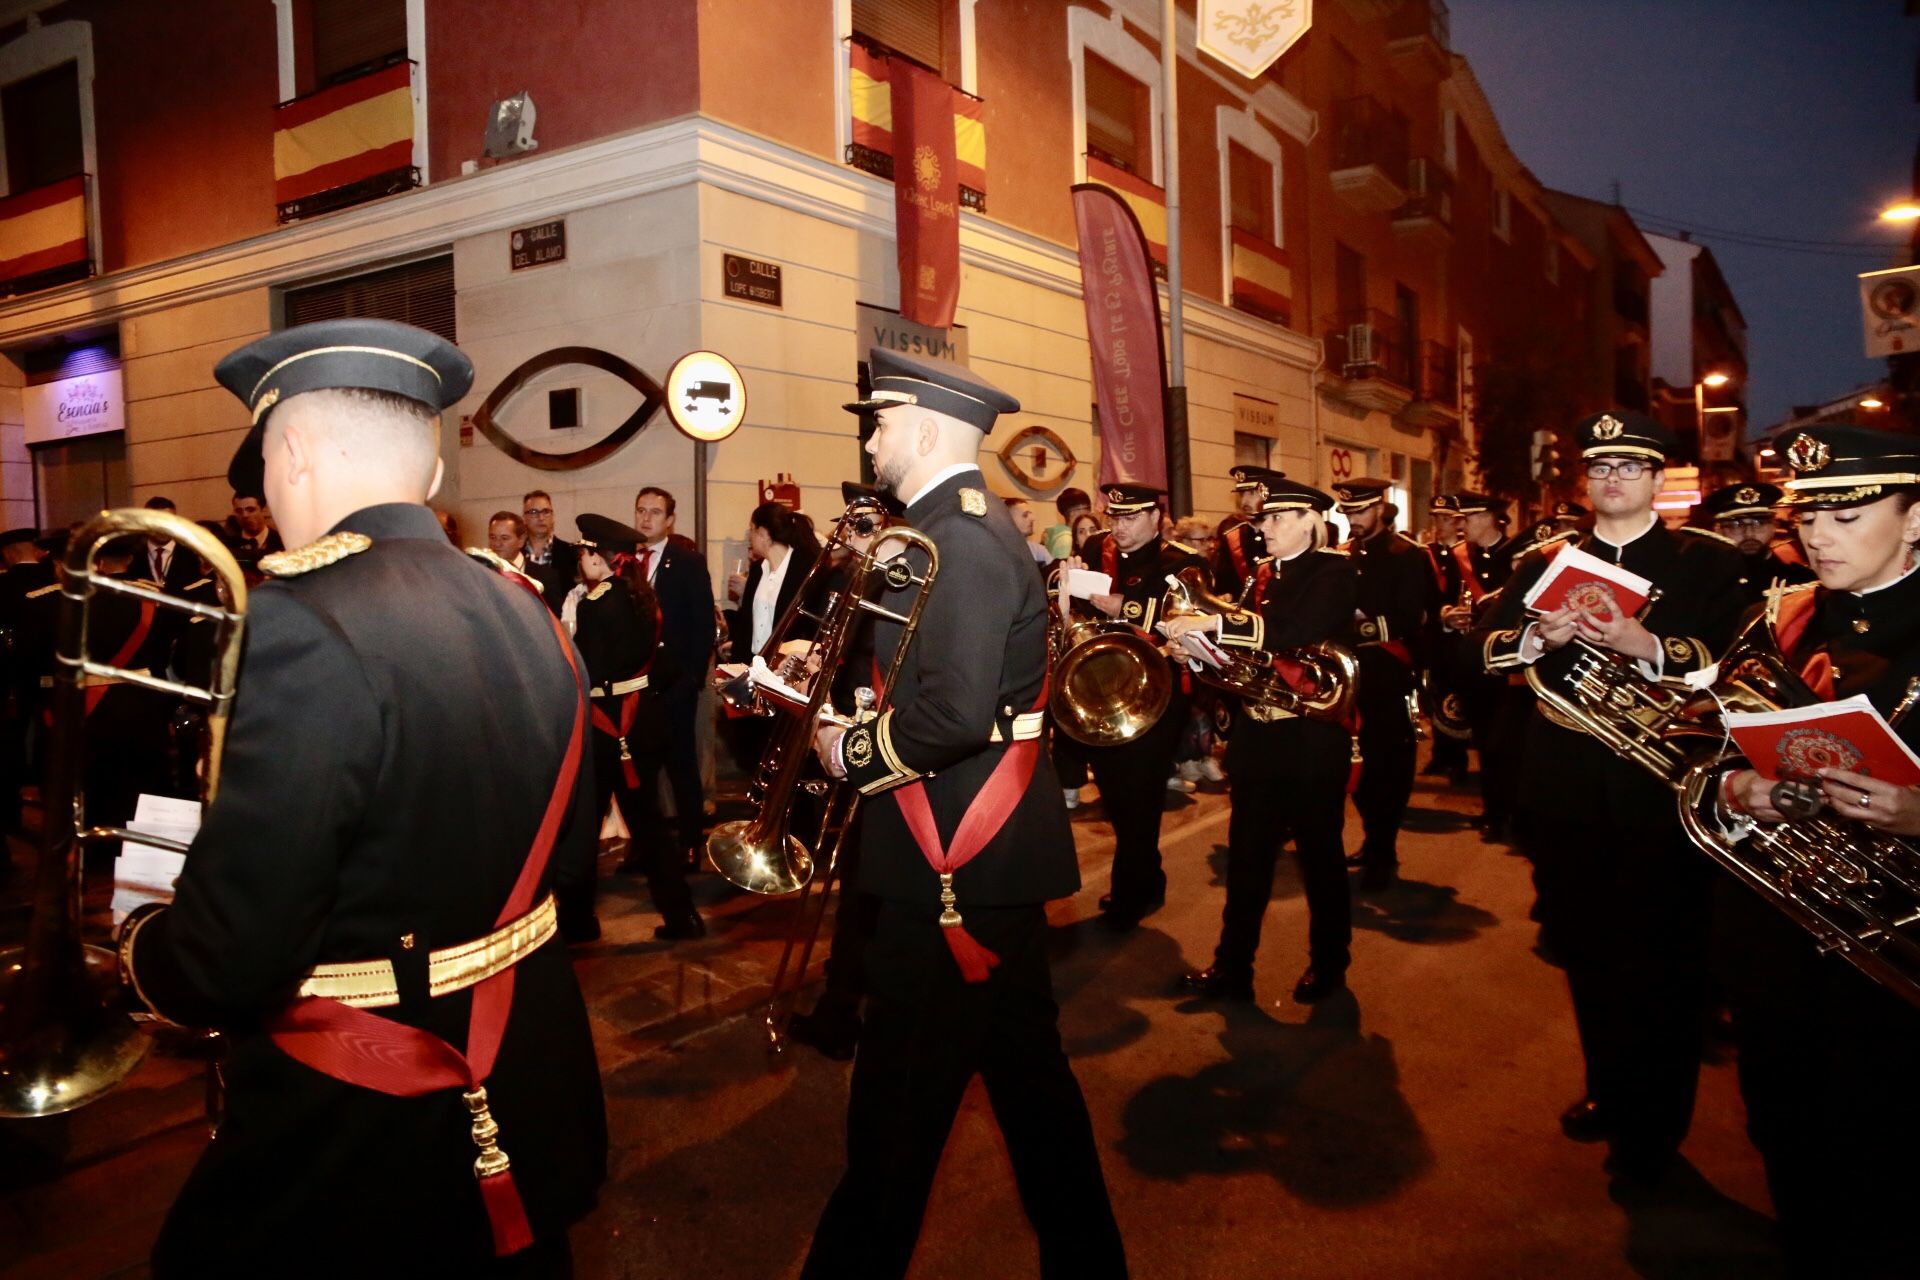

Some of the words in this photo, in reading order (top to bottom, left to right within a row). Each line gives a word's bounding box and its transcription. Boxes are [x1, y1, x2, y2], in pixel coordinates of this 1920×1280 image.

[530, 224, 558, 242] CALLE
[514, 252, 531, 267] DEL
[749, 261, 778, 279] CALLE
[873, 326, 956, 361] VISSUM
